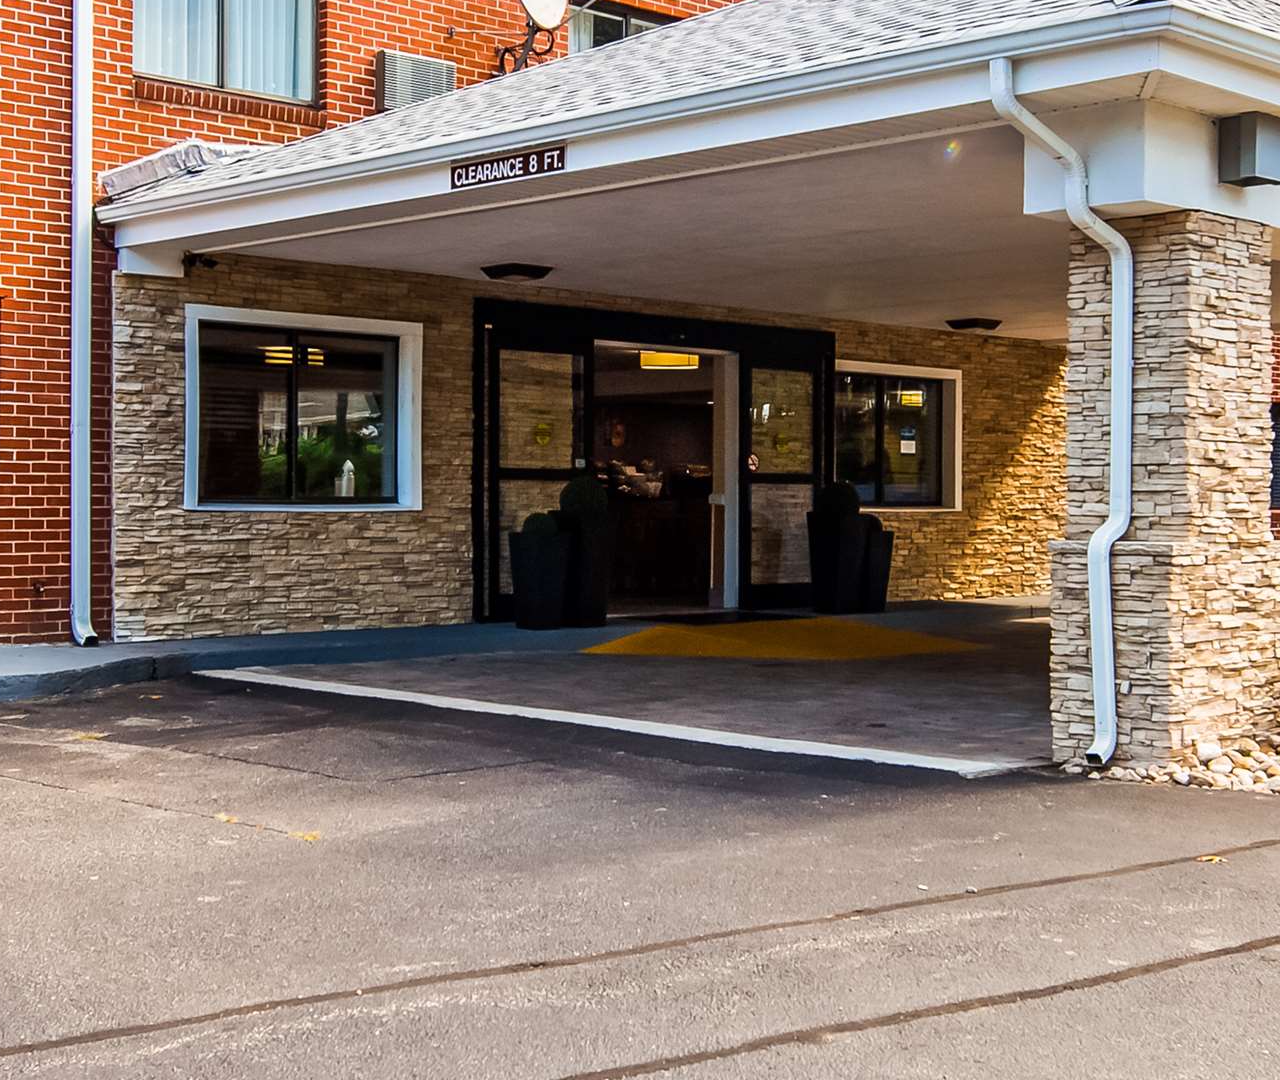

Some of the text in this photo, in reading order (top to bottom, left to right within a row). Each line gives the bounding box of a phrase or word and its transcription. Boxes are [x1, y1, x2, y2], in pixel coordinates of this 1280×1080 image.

[454, 150, 561, 186] CLEARANCE 8 FT.
